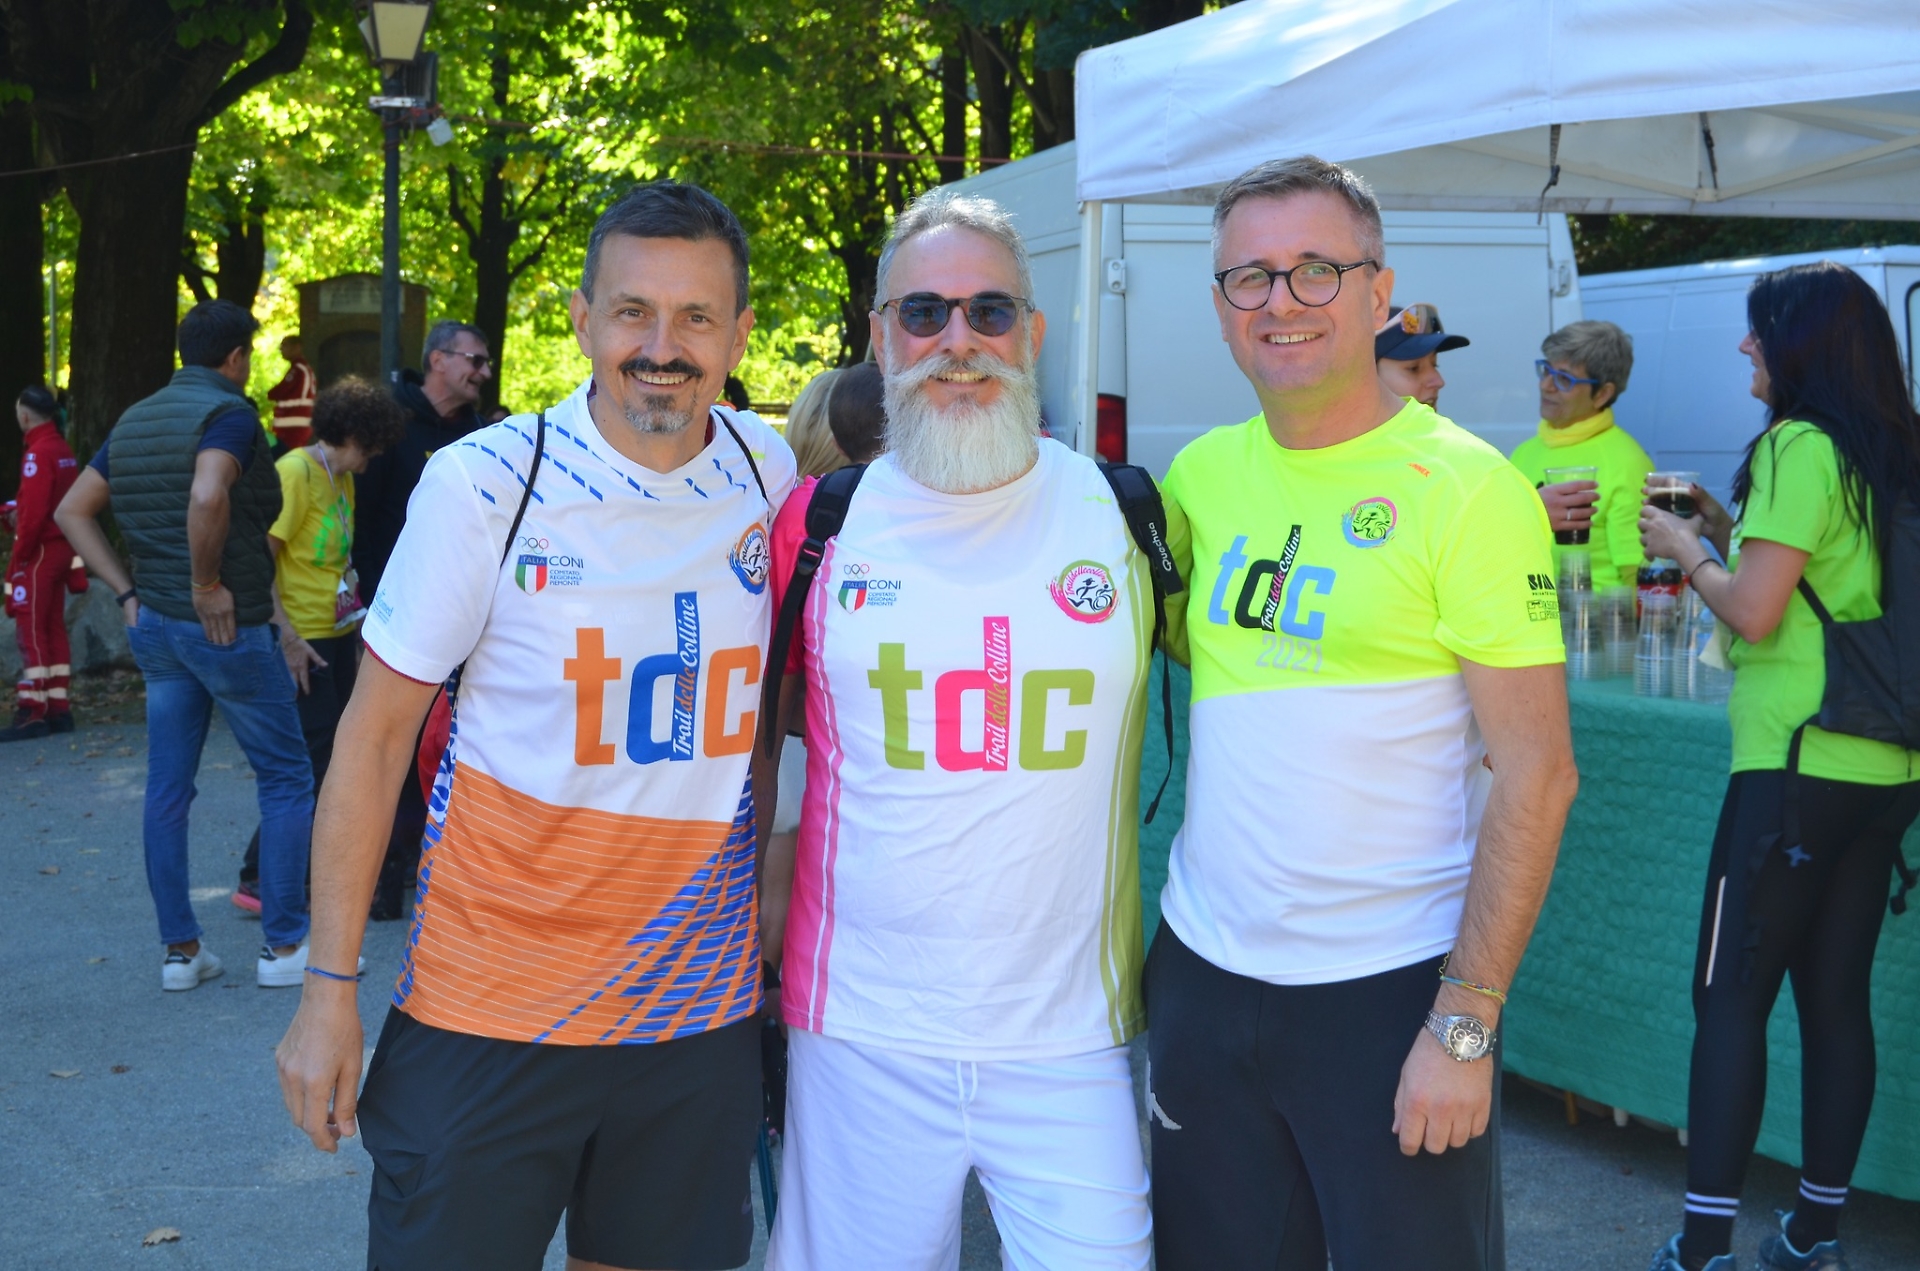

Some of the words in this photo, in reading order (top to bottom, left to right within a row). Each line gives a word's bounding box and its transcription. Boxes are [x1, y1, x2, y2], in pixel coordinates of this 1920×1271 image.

[520, 555, 545, 564] ITALIA
[548, 555, 584, 569] CONI
[1148, 522, 1172, 572] Quechua
[868, 579, 902, 590] CONI
[1208, 525, 1336, 641] tdc
[1256, 634, 1323, 674] 2021
[563, 591, 761, 766] tdc
[867, 616, 1095, 772] tdc
